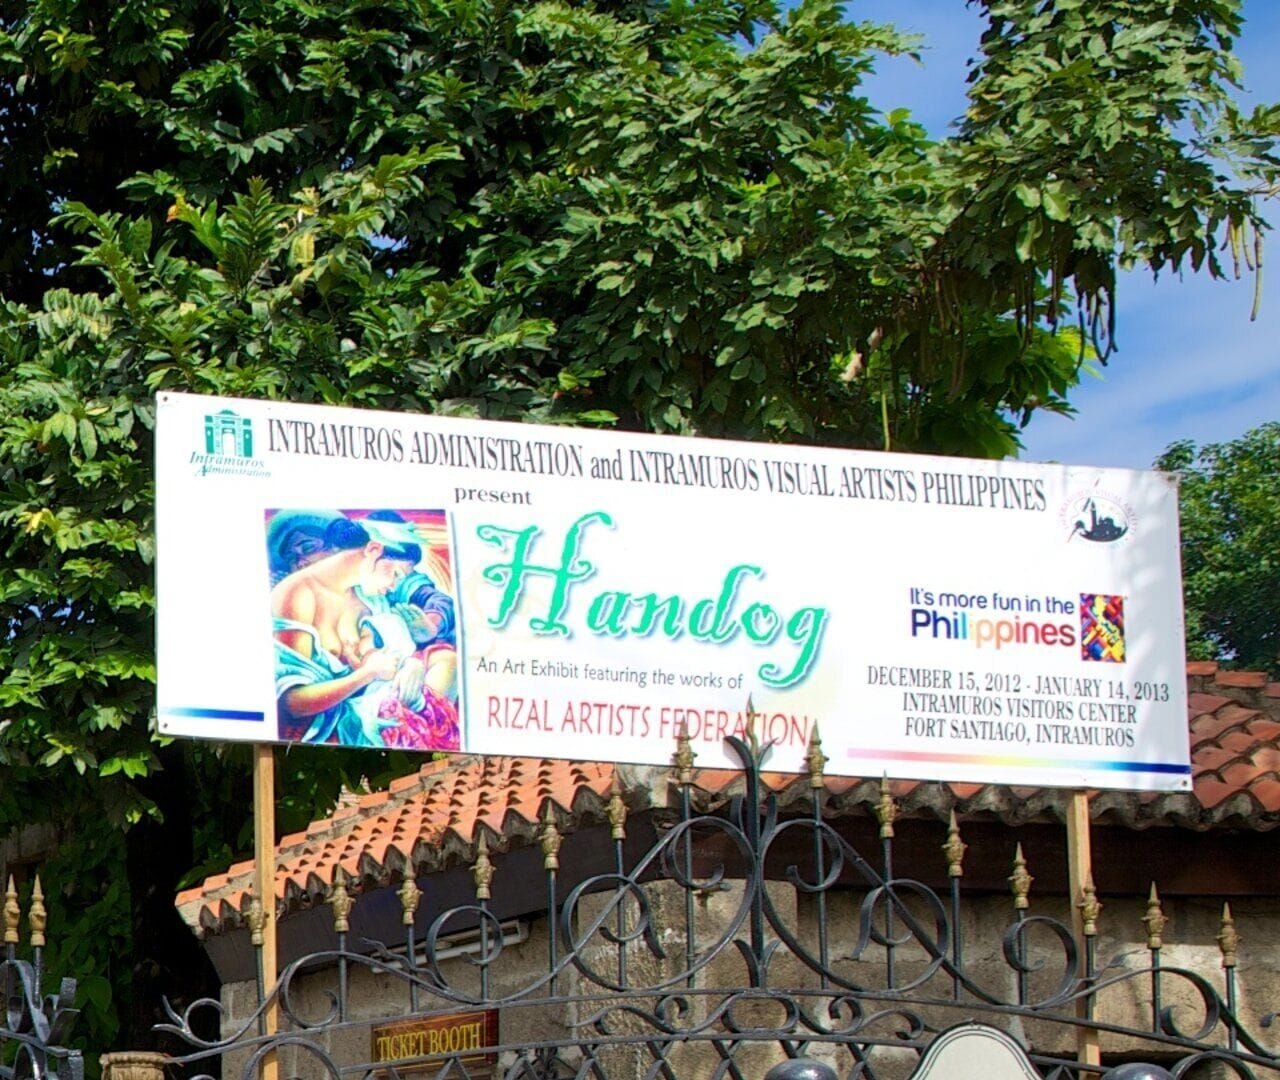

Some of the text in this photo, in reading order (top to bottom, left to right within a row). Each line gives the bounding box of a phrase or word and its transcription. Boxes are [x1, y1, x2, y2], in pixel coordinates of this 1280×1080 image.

[189, 451, 265, 468] Intramuros
[268, 418, 1047, 512] INTRAMUROS ADMINISTRATION and INTRAMUROS VISUAL ARTISTS PHILIPPINES
[454, 487, 532, 505] present
[476, 511, 826, 686] Handog
[910, 587, 1075, 614] It's more fun in the
[911, 608, 1076, 650] Philippines
[476, 657, 743, 689] An Art Exhibit featuring the works of
[867, 665, 952, 689] DECEMBER
[957, 672, 980, 693] 15,
[985, 673, 1021, 693] 2012
[1035, 675, 1101, 699] JANUARY
[1108, 680, 1130, 701] 14,
[1134, 682, 1170, 702] 2013
[488, 695, 553, 731] RIZAL
[561, 701, 651, 738] ARTISTS
[903, 692, 1137, 724] INTRAMUROS VISITORS CENTER
[905, 716, 1135, 748] FORT SANTIAGO, INTRAMUROS
[377, 1022, 480, 1061] TICKET BOOTH
